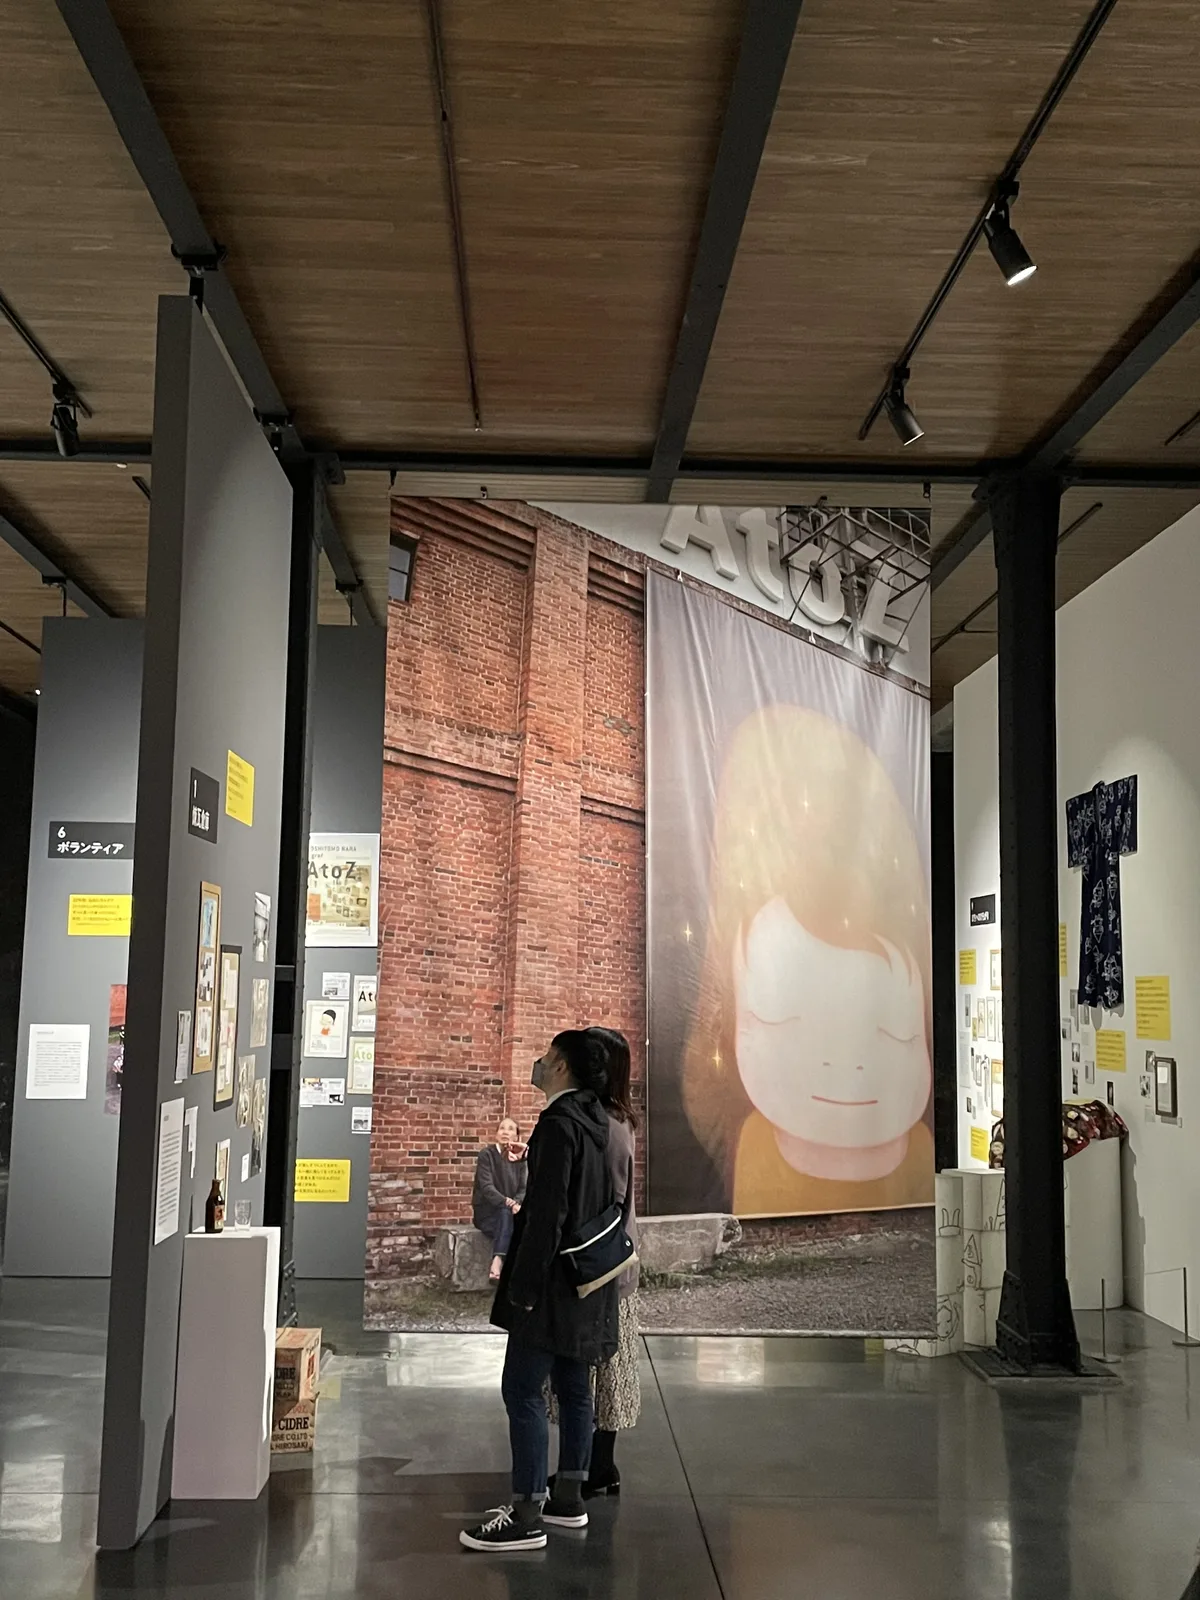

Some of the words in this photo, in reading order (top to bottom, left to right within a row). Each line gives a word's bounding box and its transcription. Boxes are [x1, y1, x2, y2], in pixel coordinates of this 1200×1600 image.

[57, 826, 66, 839] 6
[56, 840, 125, 855] ボランティア
[358, 990, 377, 1002] At
[278, 1416, 309, 1431] CIDRE
